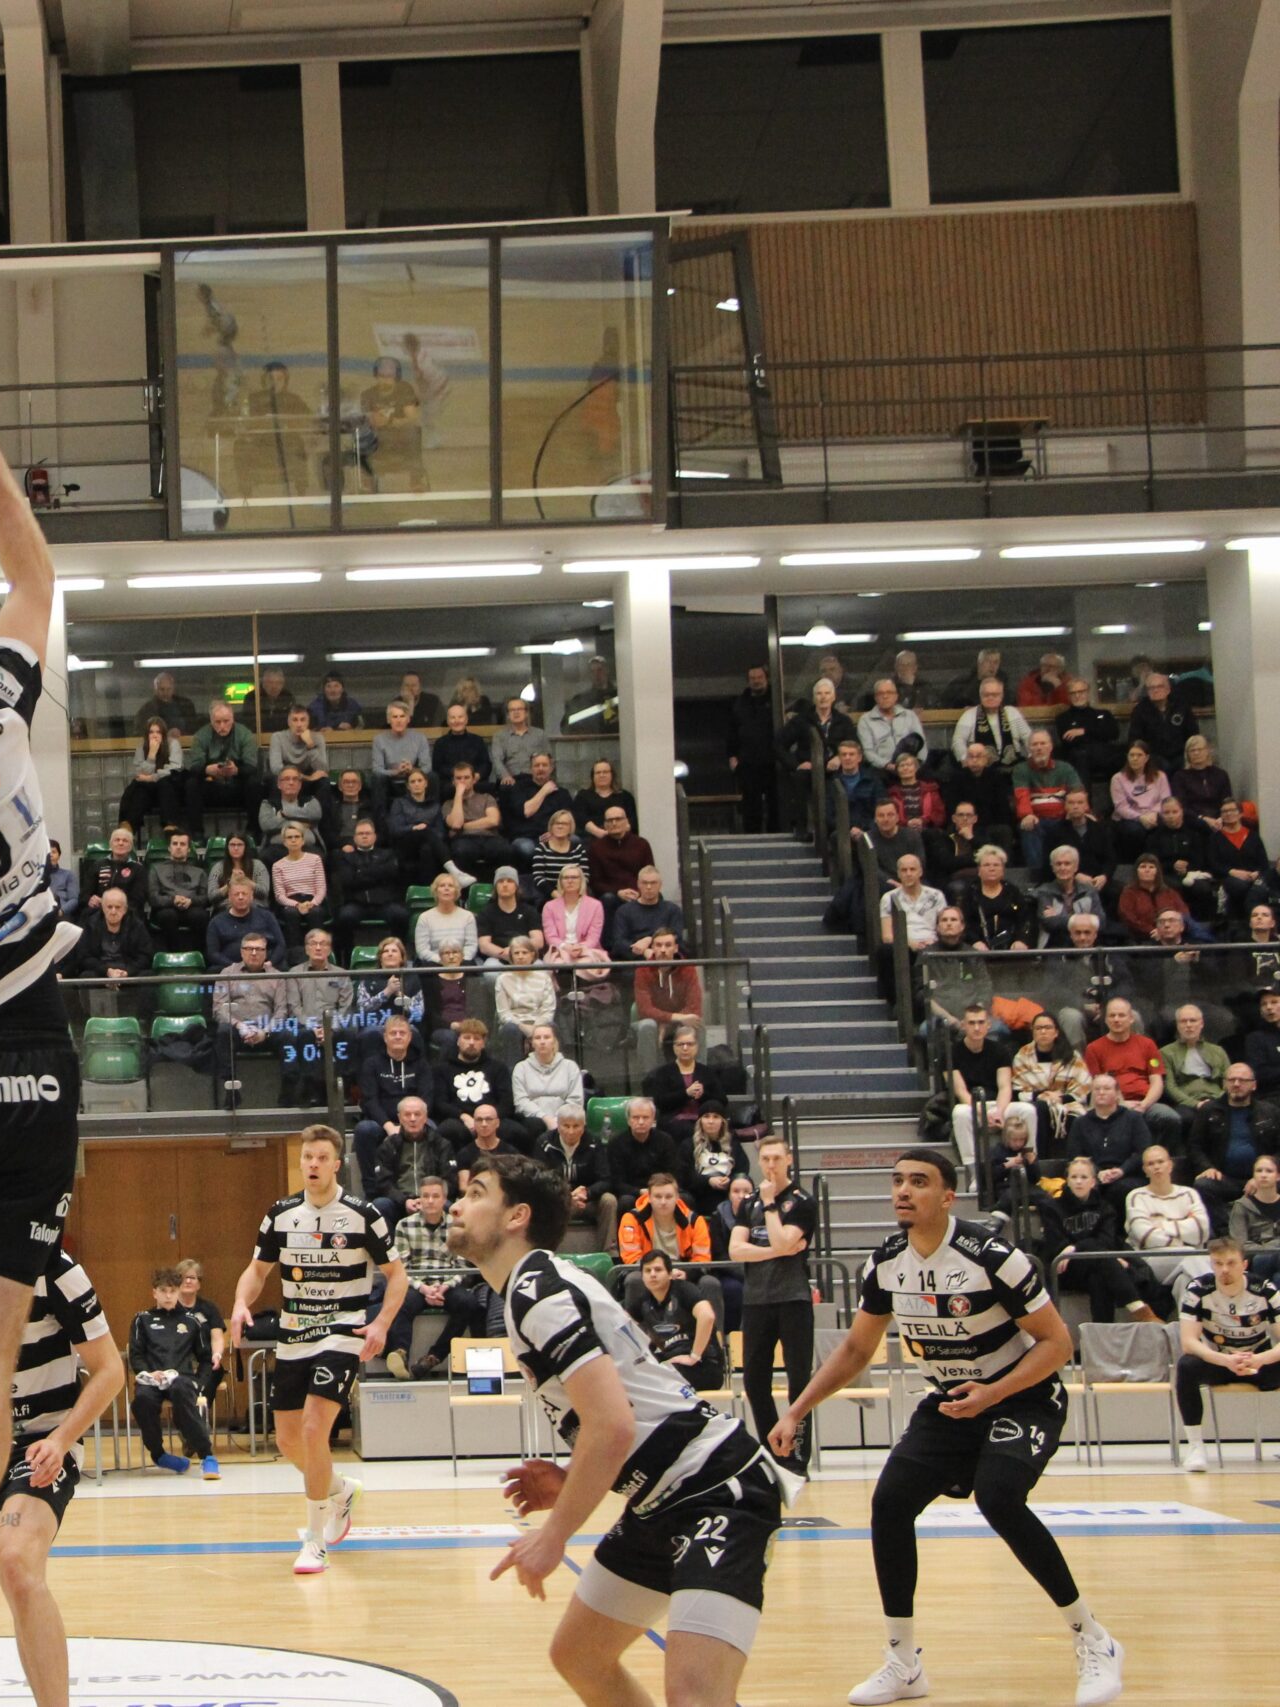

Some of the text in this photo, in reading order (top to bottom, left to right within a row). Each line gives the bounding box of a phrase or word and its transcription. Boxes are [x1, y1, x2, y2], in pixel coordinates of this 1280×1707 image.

[291, 1251, 340, 1264] TELILÄ
[918, 1270, 936, 1292] 14
[304, 1287, 335, 1297] Vexve
[902, 1321, 970, 1337] TELILÄ
[936, 1366, 982, 1377] Vexve
[1030, 1425, 1045, 1446] 14
[694, 1515, 729, 1542] 22
